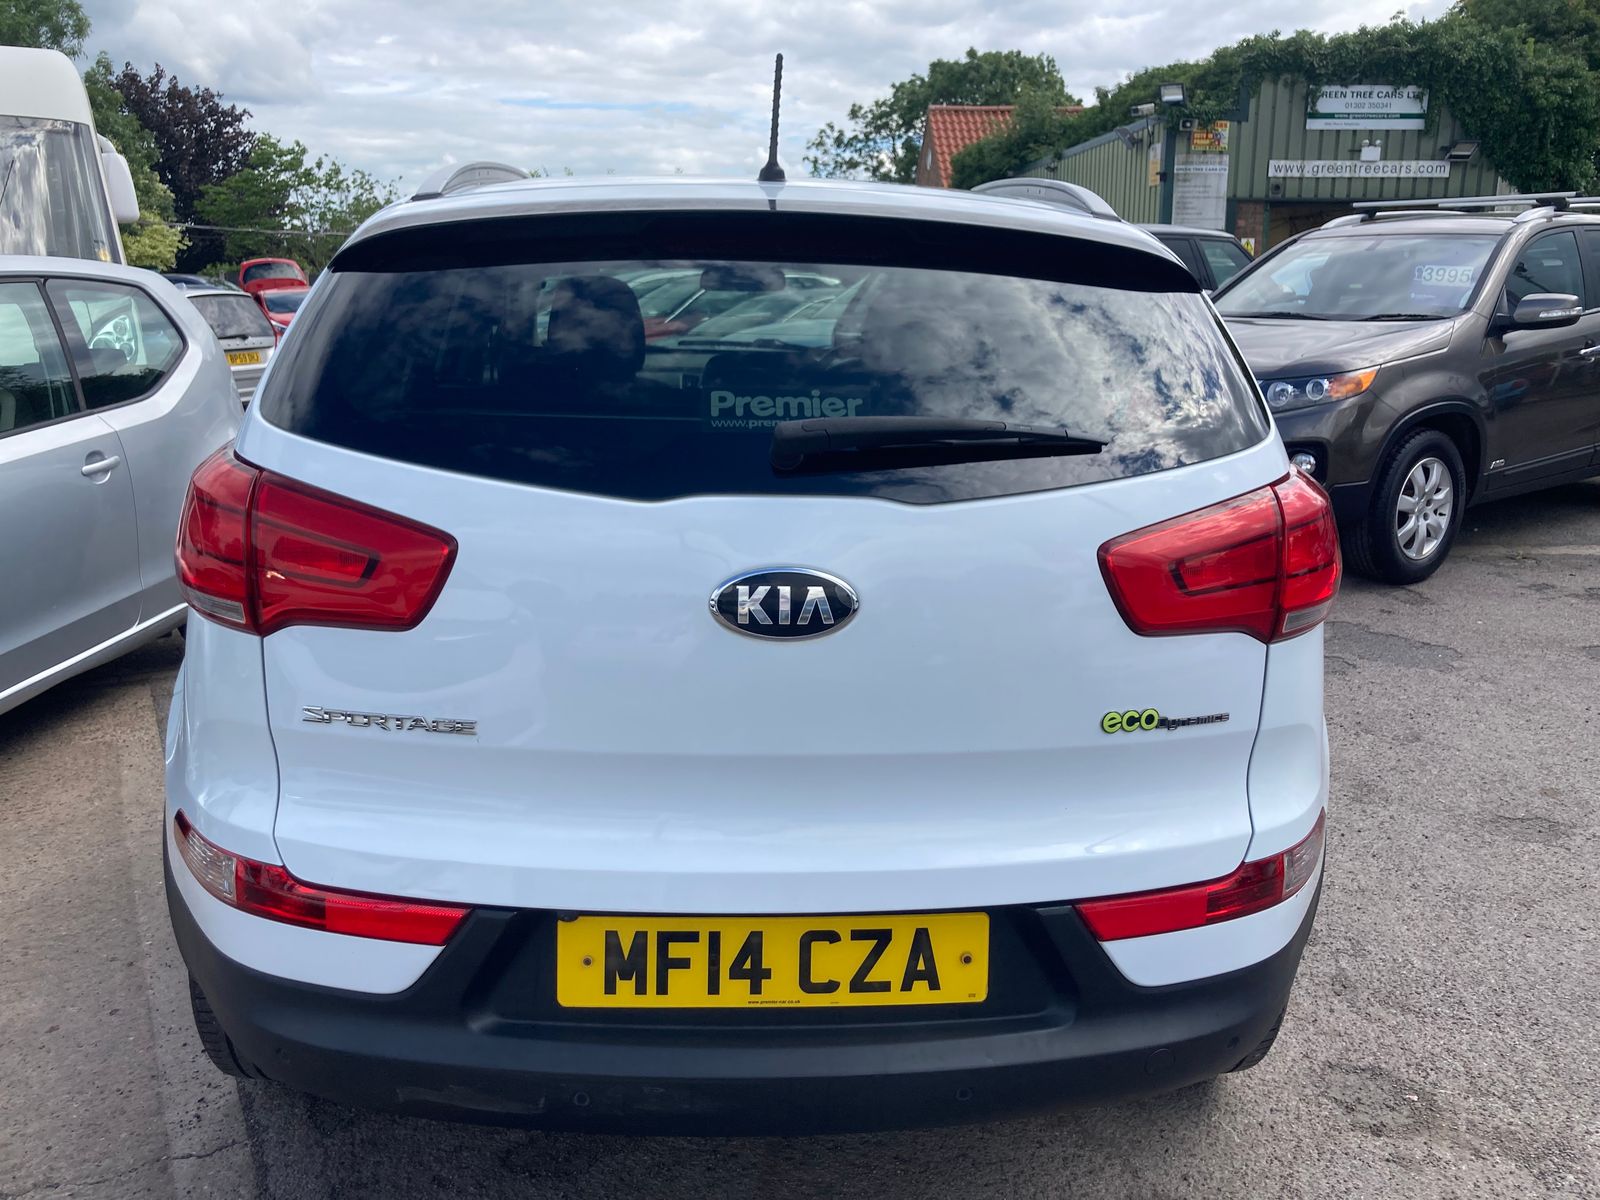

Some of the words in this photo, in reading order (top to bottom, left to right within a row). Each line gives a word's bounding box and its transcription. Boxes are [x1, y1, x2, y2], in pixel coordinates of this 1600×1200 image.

[1320, 90, 1348, 99] REEN
[1350, 90, 1375, 99] TREE
[1376, 90, 1405, 99] CARS
[1406, 90, 1422, 99] LT
[1273, 162, 1447, 176] www.greentreecars.com
[710, 389, 863, 417] Premier
[736, 585, 835, 625] KIA
[302, 705, 477, 735] SPORTAGE
[604, 930, 772, 995] MF14
[799, 927, 941, 994] CZA
